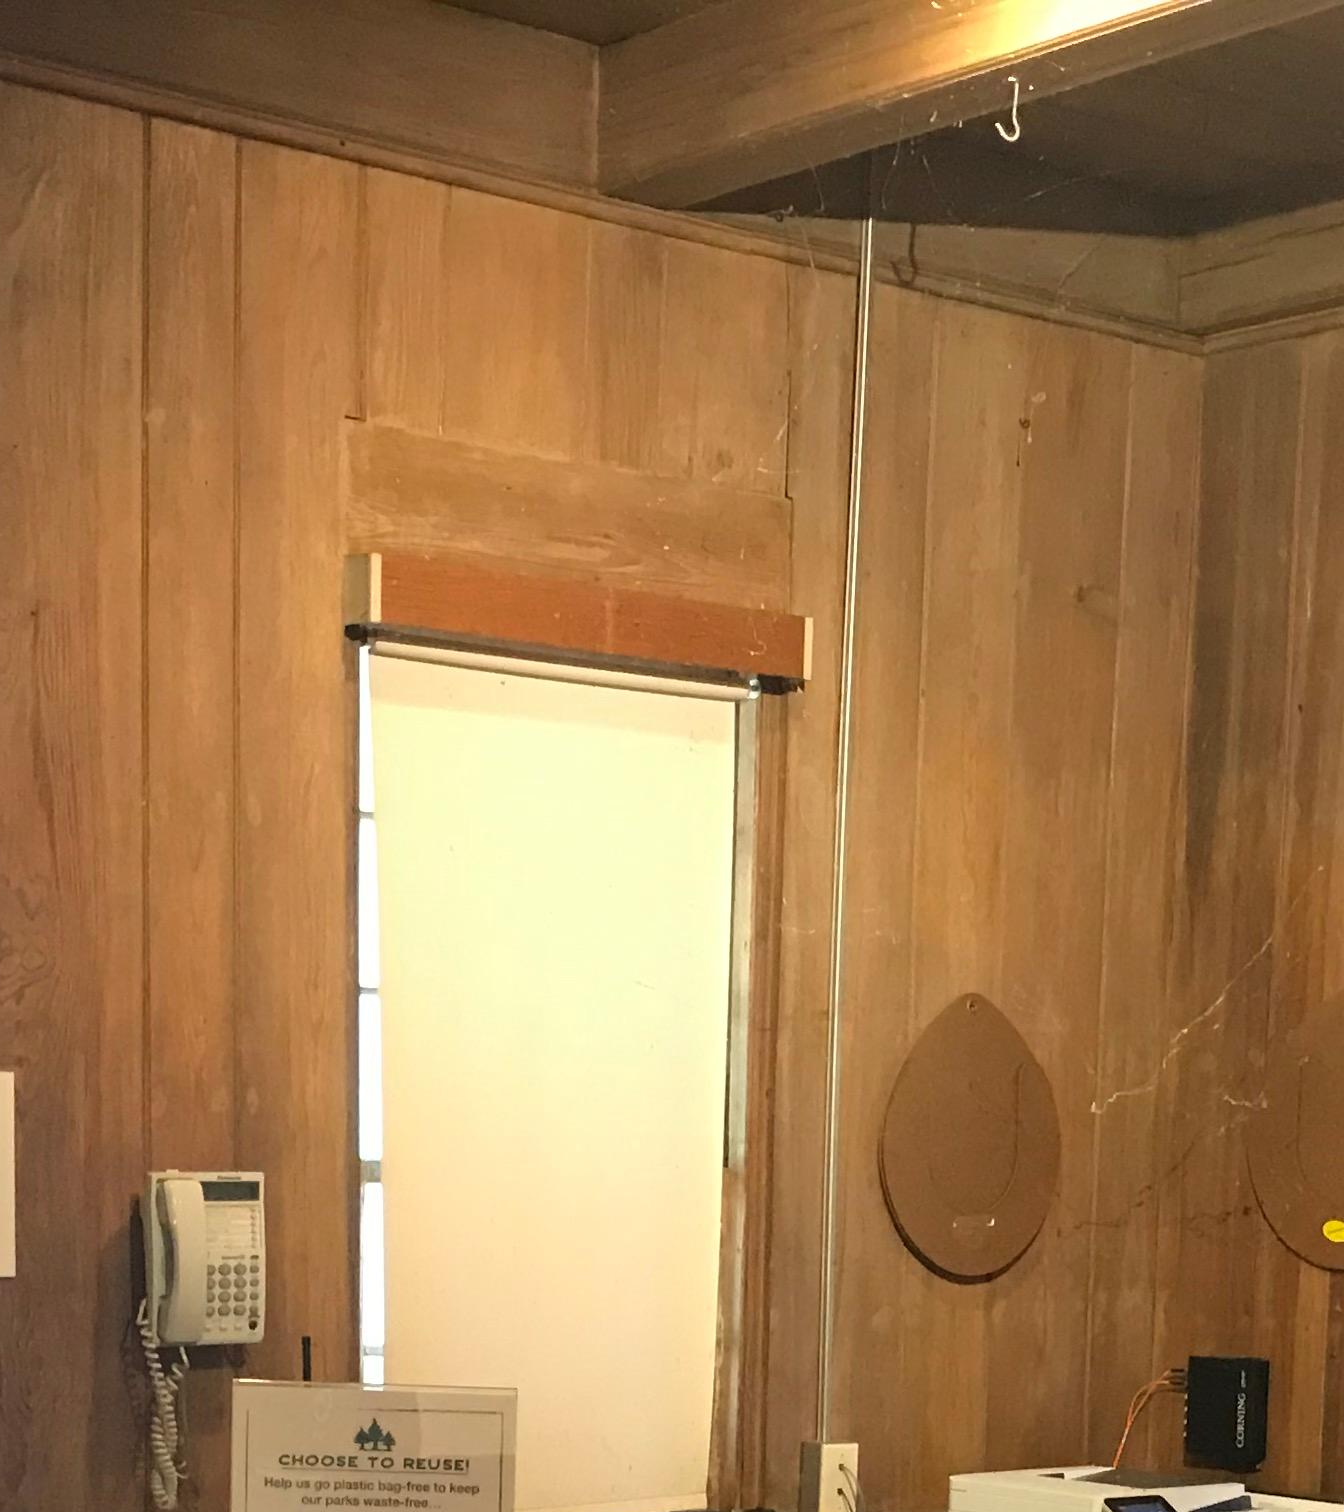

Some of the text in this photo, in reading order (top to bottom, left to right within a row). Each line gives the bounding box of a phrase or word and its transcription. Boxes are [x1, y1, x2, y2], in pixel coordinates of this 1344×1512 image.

[1236, 1393, 1246, 1448] CORNING
[278, 1454, 470, 1471] CHOOSE TO REUSE!
[264, 1476, 480, 1496] Help us go plastic bag-free to keep
[302, 1496, 320, 1505] our
[325, 1495, 360, 1507] parks
